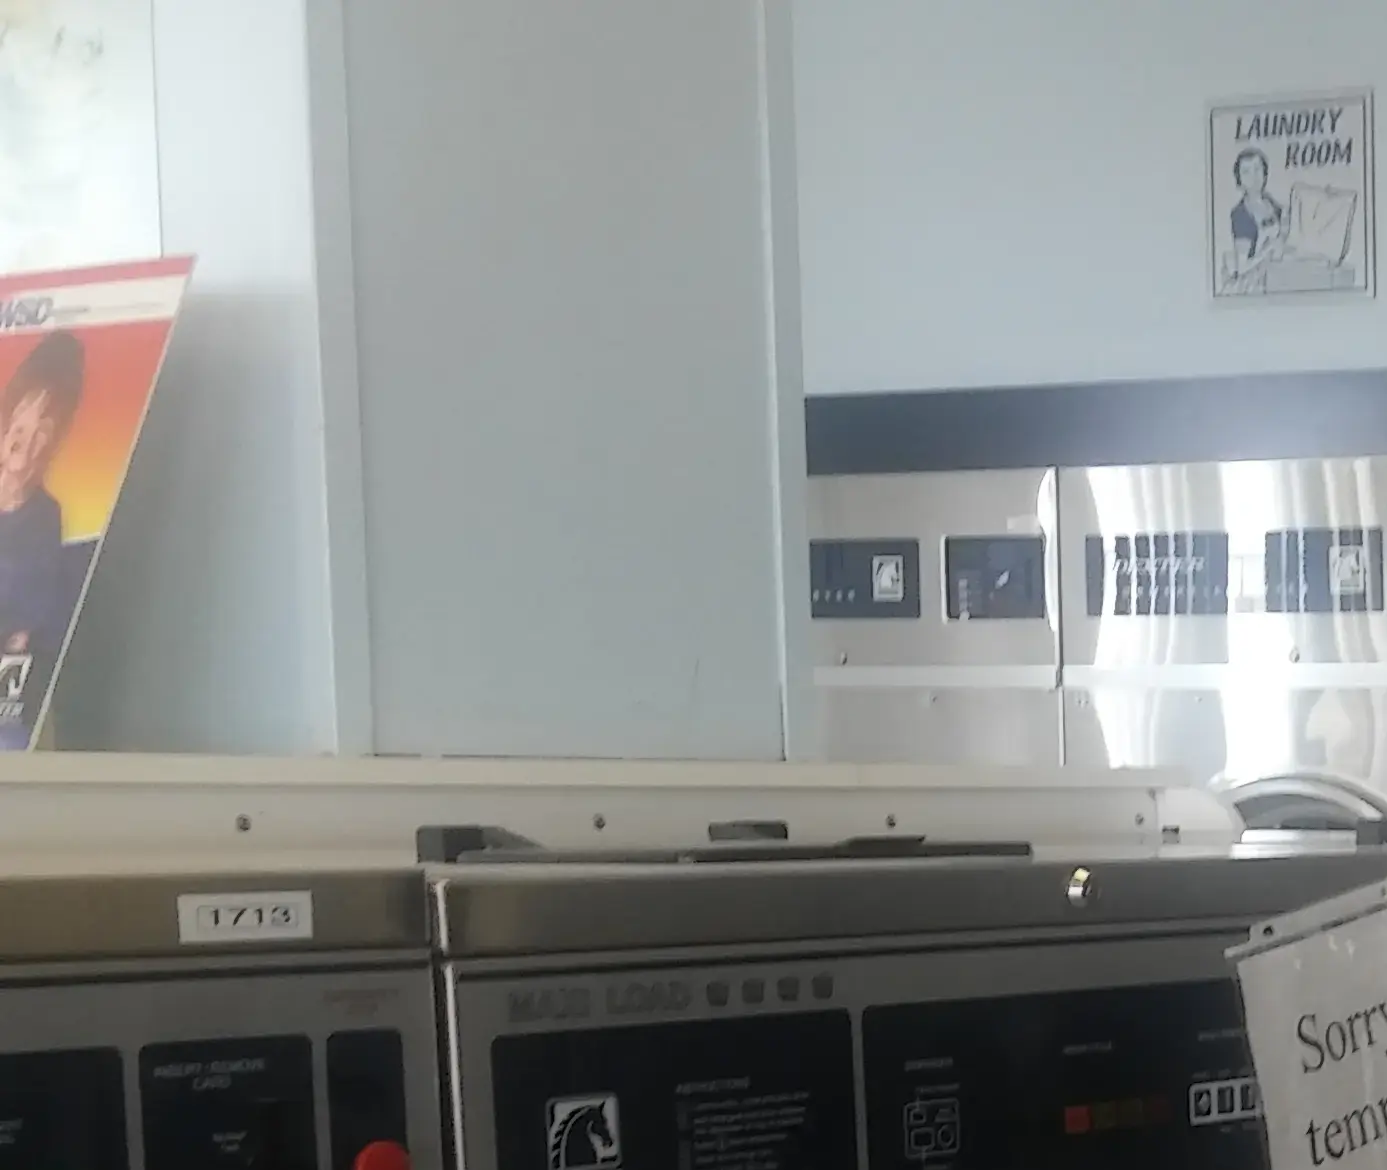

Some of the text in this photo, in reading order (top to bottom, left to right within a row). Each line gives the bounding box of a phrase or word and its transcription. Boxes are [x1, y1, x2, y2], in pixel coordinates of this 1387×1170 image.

[1235, 107, 1345, 141] LAUNDRY
[1284, 137, 1354, 170] ROOM
[211, 906, 292, 928] 1713
